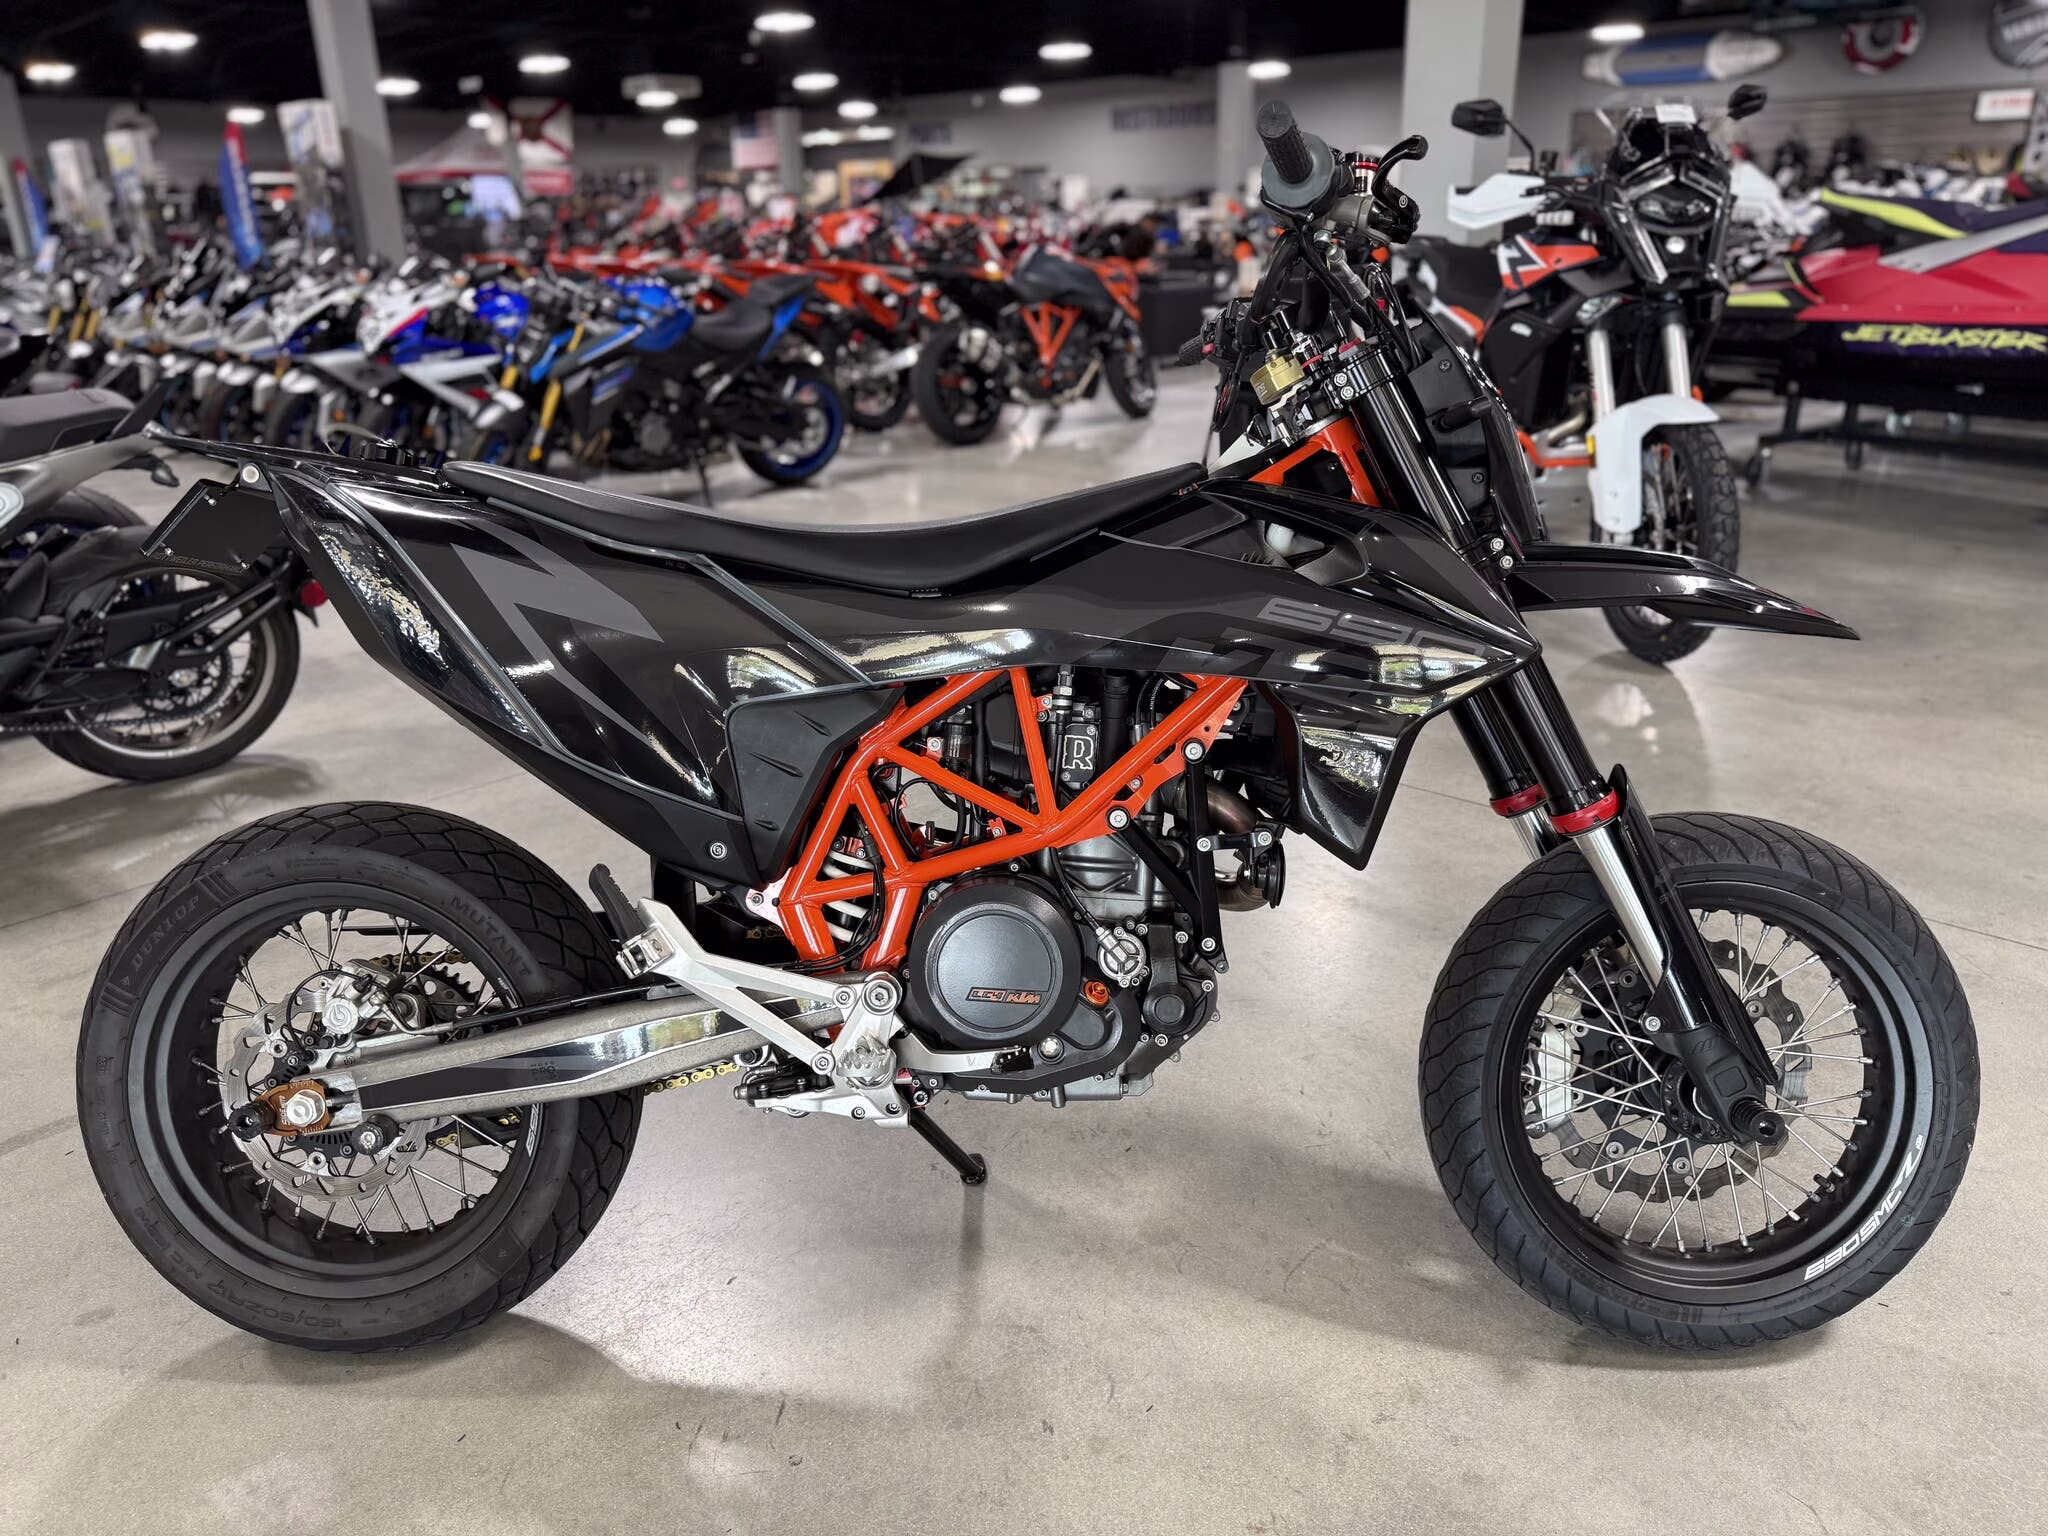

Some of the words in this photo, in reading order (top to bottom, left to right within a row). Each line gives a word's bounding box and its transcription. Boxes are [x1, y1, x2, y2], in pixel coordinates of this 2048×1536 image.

[1062, 734, 1094, 770] R
[130, 895, 200, 973] DUNLOP
[450, 894, 533, 977] MUTANT
